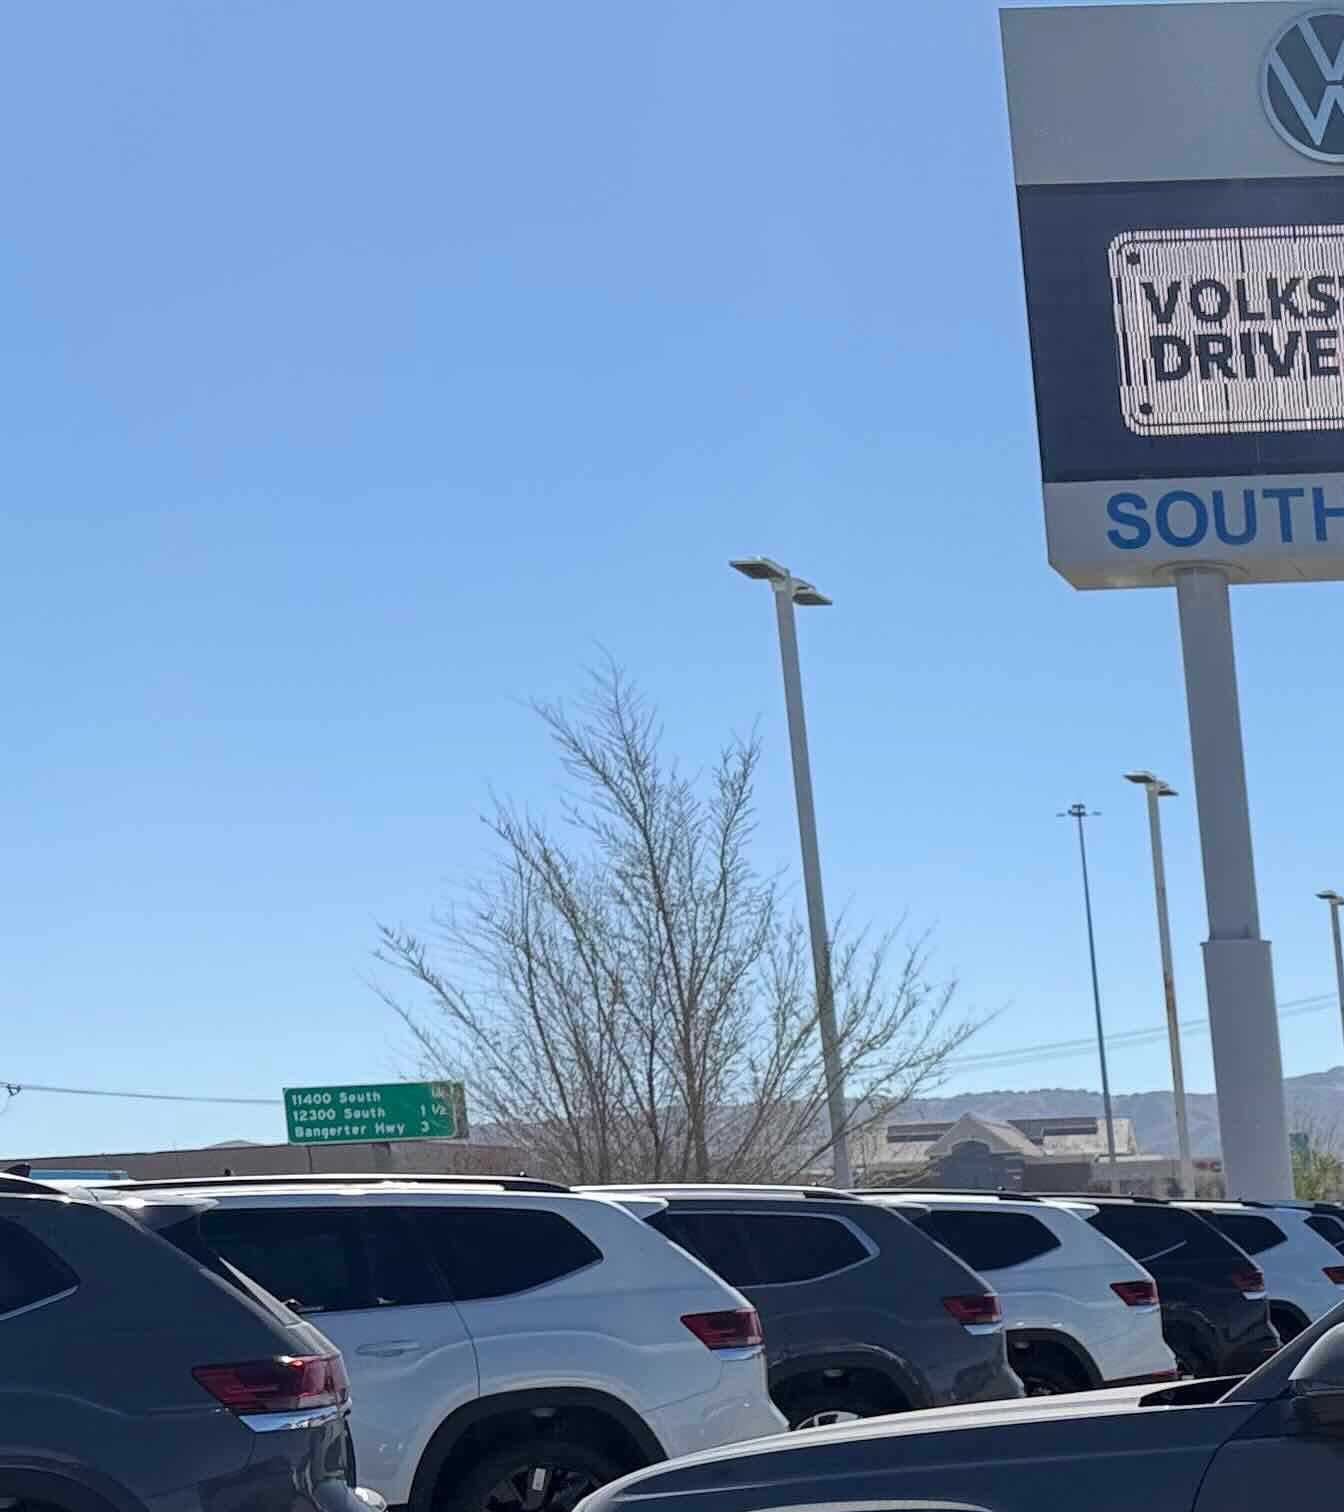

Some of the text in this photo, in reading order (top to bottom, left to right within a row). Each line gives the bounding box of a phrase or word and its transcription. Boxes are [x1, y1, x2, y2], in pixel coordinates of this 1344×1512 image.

[291, 1093, 332, 1106] 11400
[339, 1091, 381, 1104] South
[293, 1108, 337, 1122] 12300
[344, 1106, 386, 1120] South
[295, 1125, 368, 1140] Bangerter
[375, 1121, 407, 1137] Hwy
